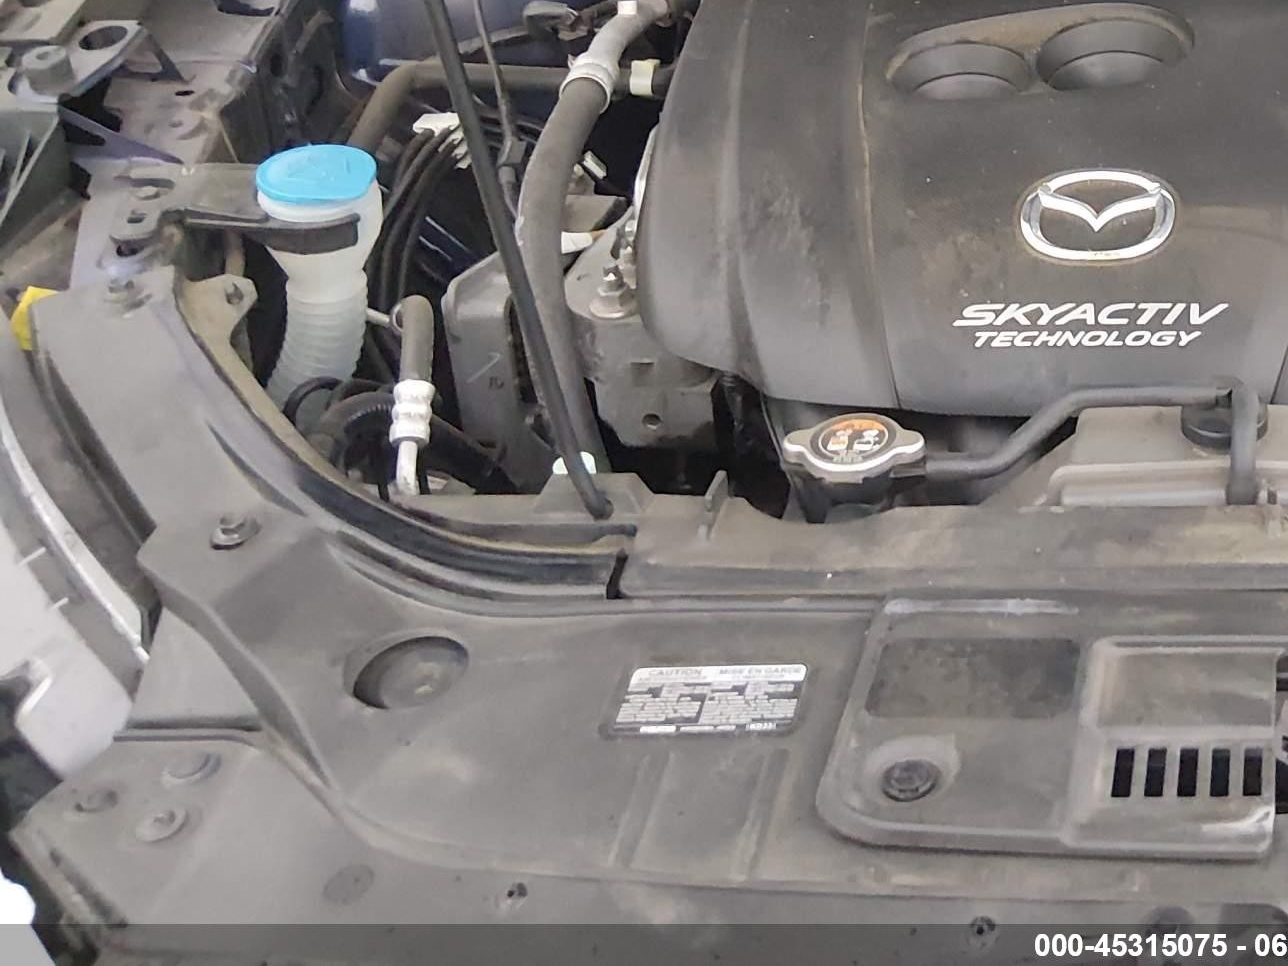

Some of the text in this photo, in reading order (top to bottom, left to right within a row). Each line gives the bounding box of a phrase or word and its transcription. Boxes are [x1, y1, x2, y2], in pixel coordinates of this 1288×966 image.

[951, 302, 1230, 327] SKYACTIV
[972, 329, 1203, 348] TECHNOLOGY
[648, 668, 703, 676] CAUTION
